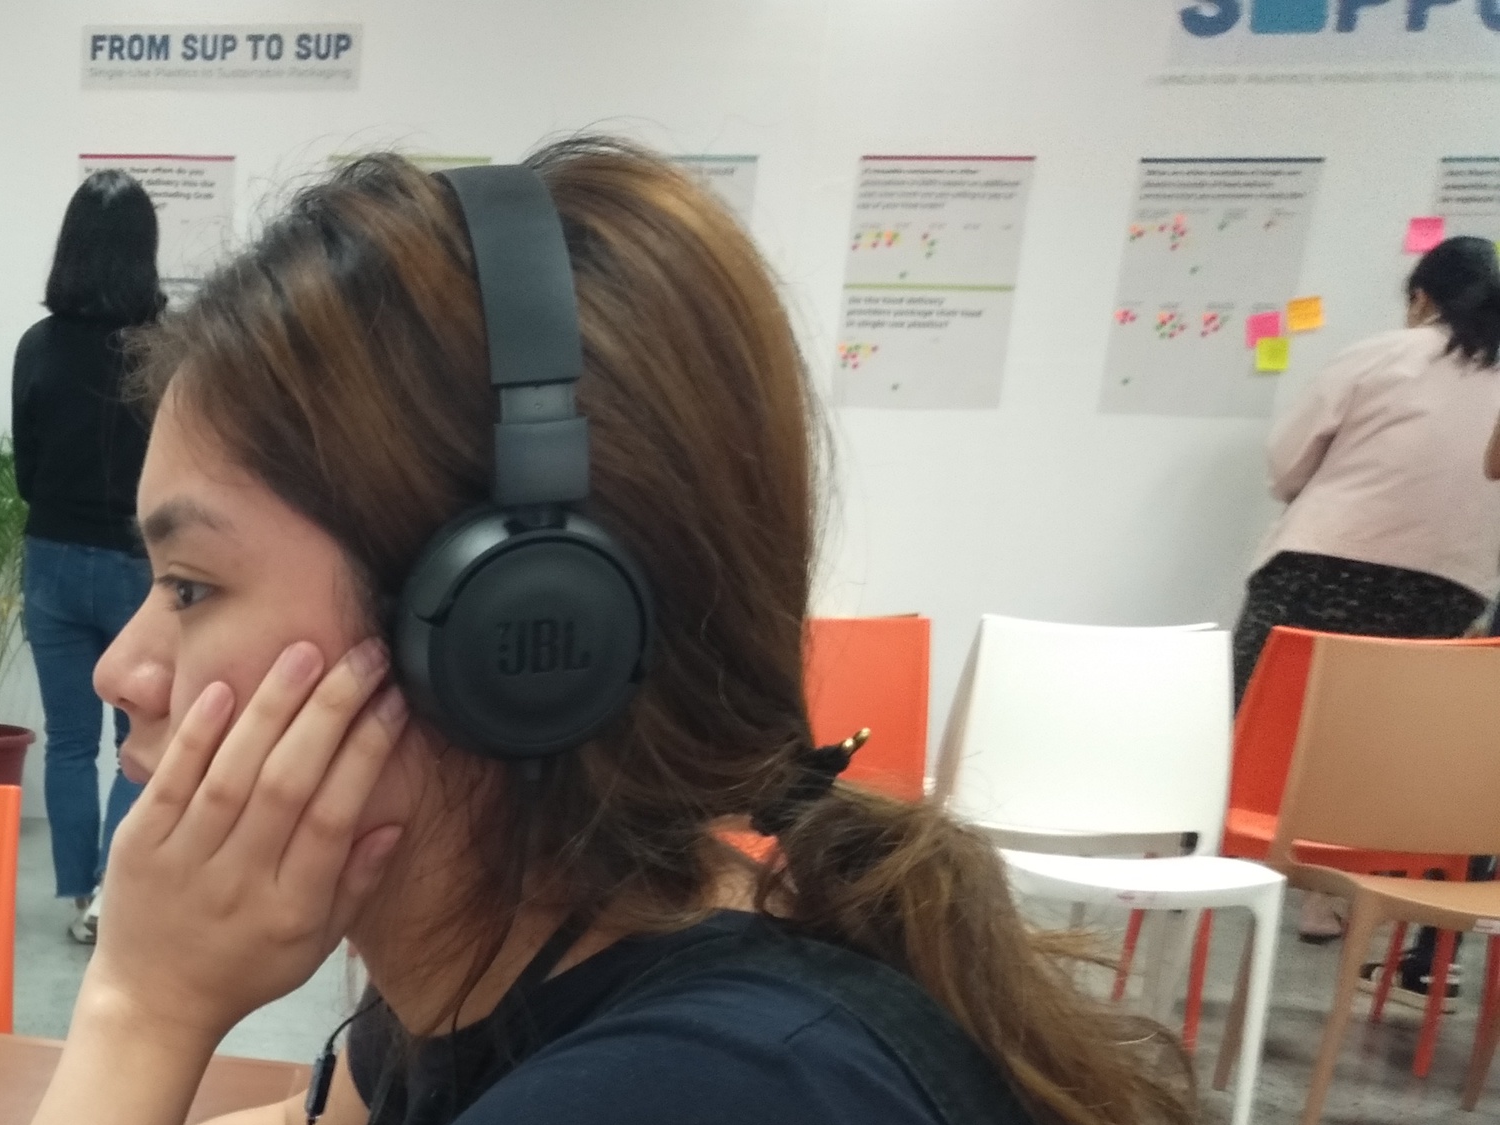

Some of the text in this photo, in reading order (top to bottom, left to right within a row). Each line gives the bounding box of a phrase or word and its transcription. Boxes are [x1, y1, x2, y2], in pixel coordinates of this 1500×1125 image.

[90, 33, 352, 61] FROM SUP TO SUP
[497, 618, 592, 676] JBL
